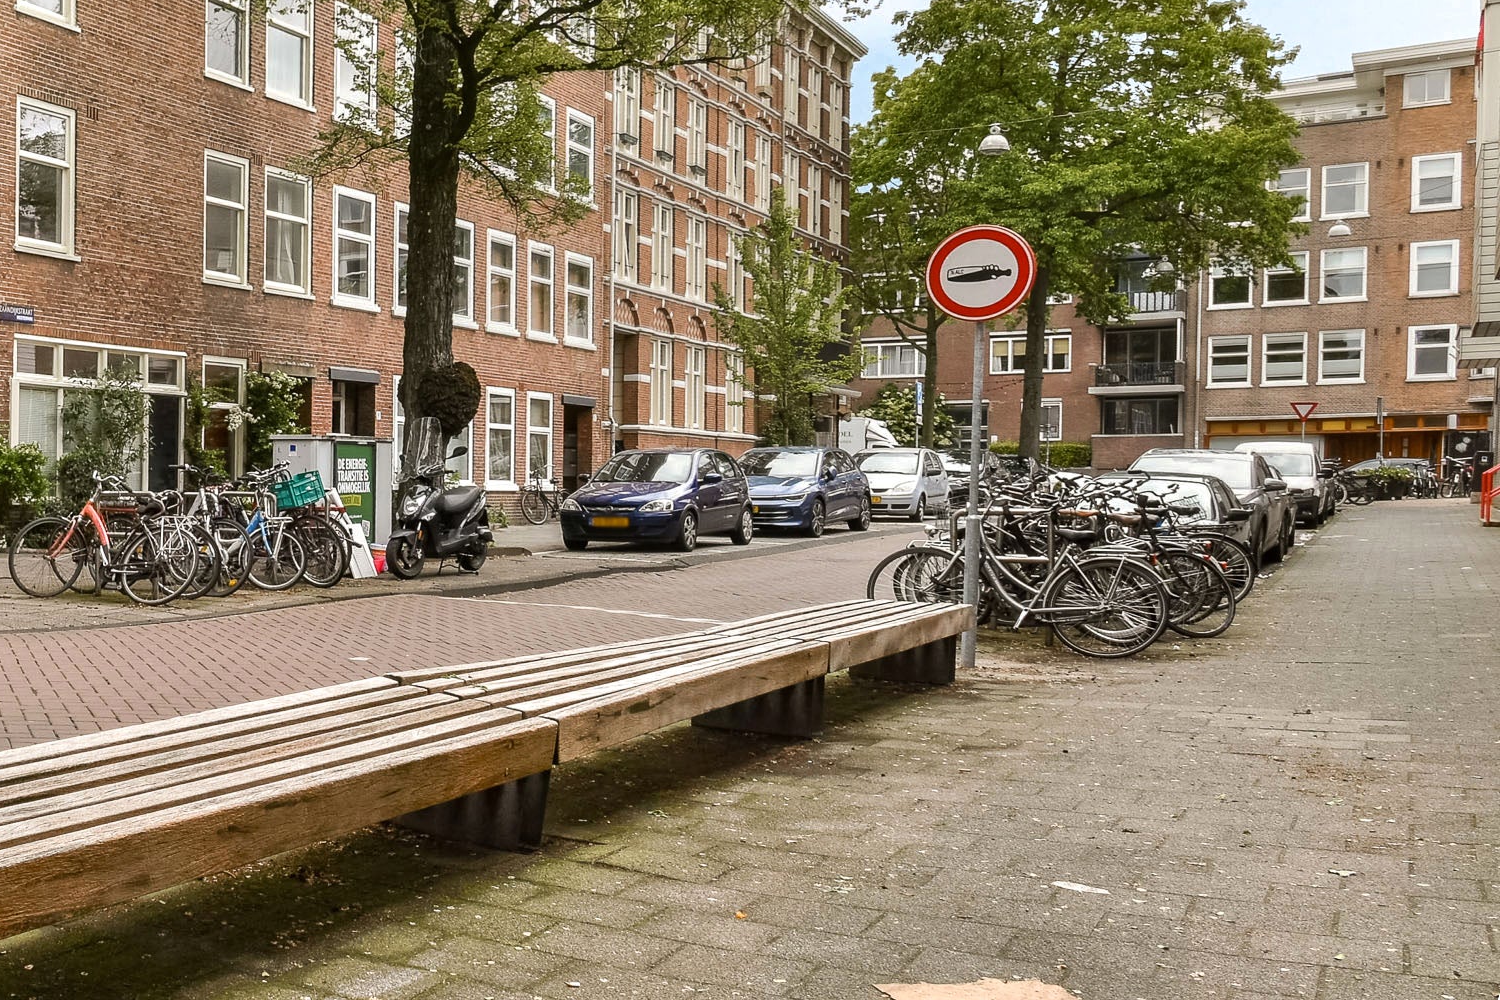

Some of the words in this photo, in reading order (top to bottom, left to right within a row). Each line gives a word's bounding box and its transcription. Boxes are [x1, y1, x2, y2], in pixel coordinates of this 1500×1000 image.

[337, 458, 345, 469] DE
[337, 470, 363, 481] TRANSITIE
[363, 470, 369, 481] IS
[337, 481, 370, 493] ONMOGELIJK
